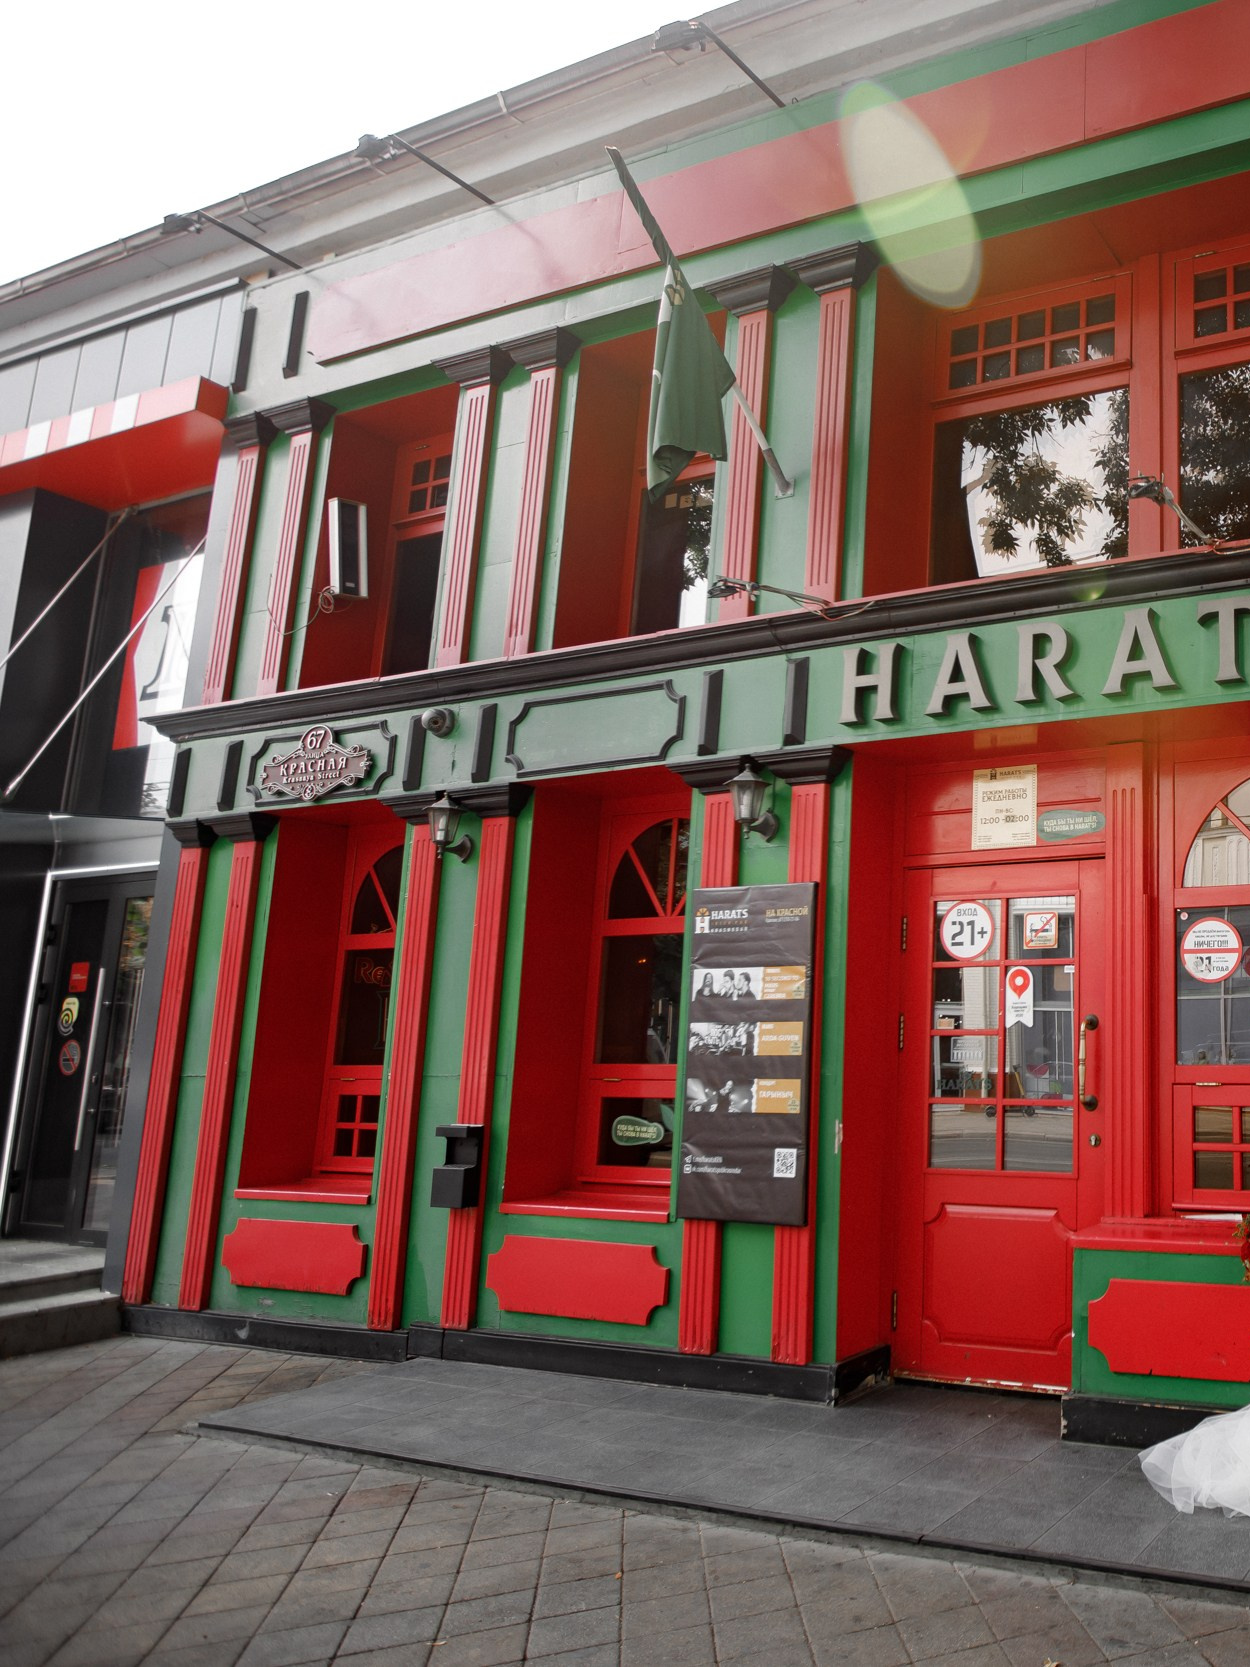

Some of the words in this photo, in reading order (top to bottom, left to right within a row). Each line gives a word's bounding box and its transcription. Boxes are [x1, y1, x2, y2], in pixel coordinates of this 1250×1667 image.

[307, 730, 326, 750] 67
[280, 756, 347, 777] КРАСНАЯ
[317, 771, 340, 780] Street
[1004, 787, 1027, 795] РАБОТЫ
[982, 793, 1028, 803] ЕЖЕДНЕВНО
[980, 817, 1000, 825] 12:00
[711, 908, 749, 920] HARATS
[777, 906, 808, 917] КРАСНОЙ
[957, 908, 978, 917] ВХОД
[951, 920, 988, 947] 21+
[1194, 939, 1229, 948] НИЧЕГО!!!
